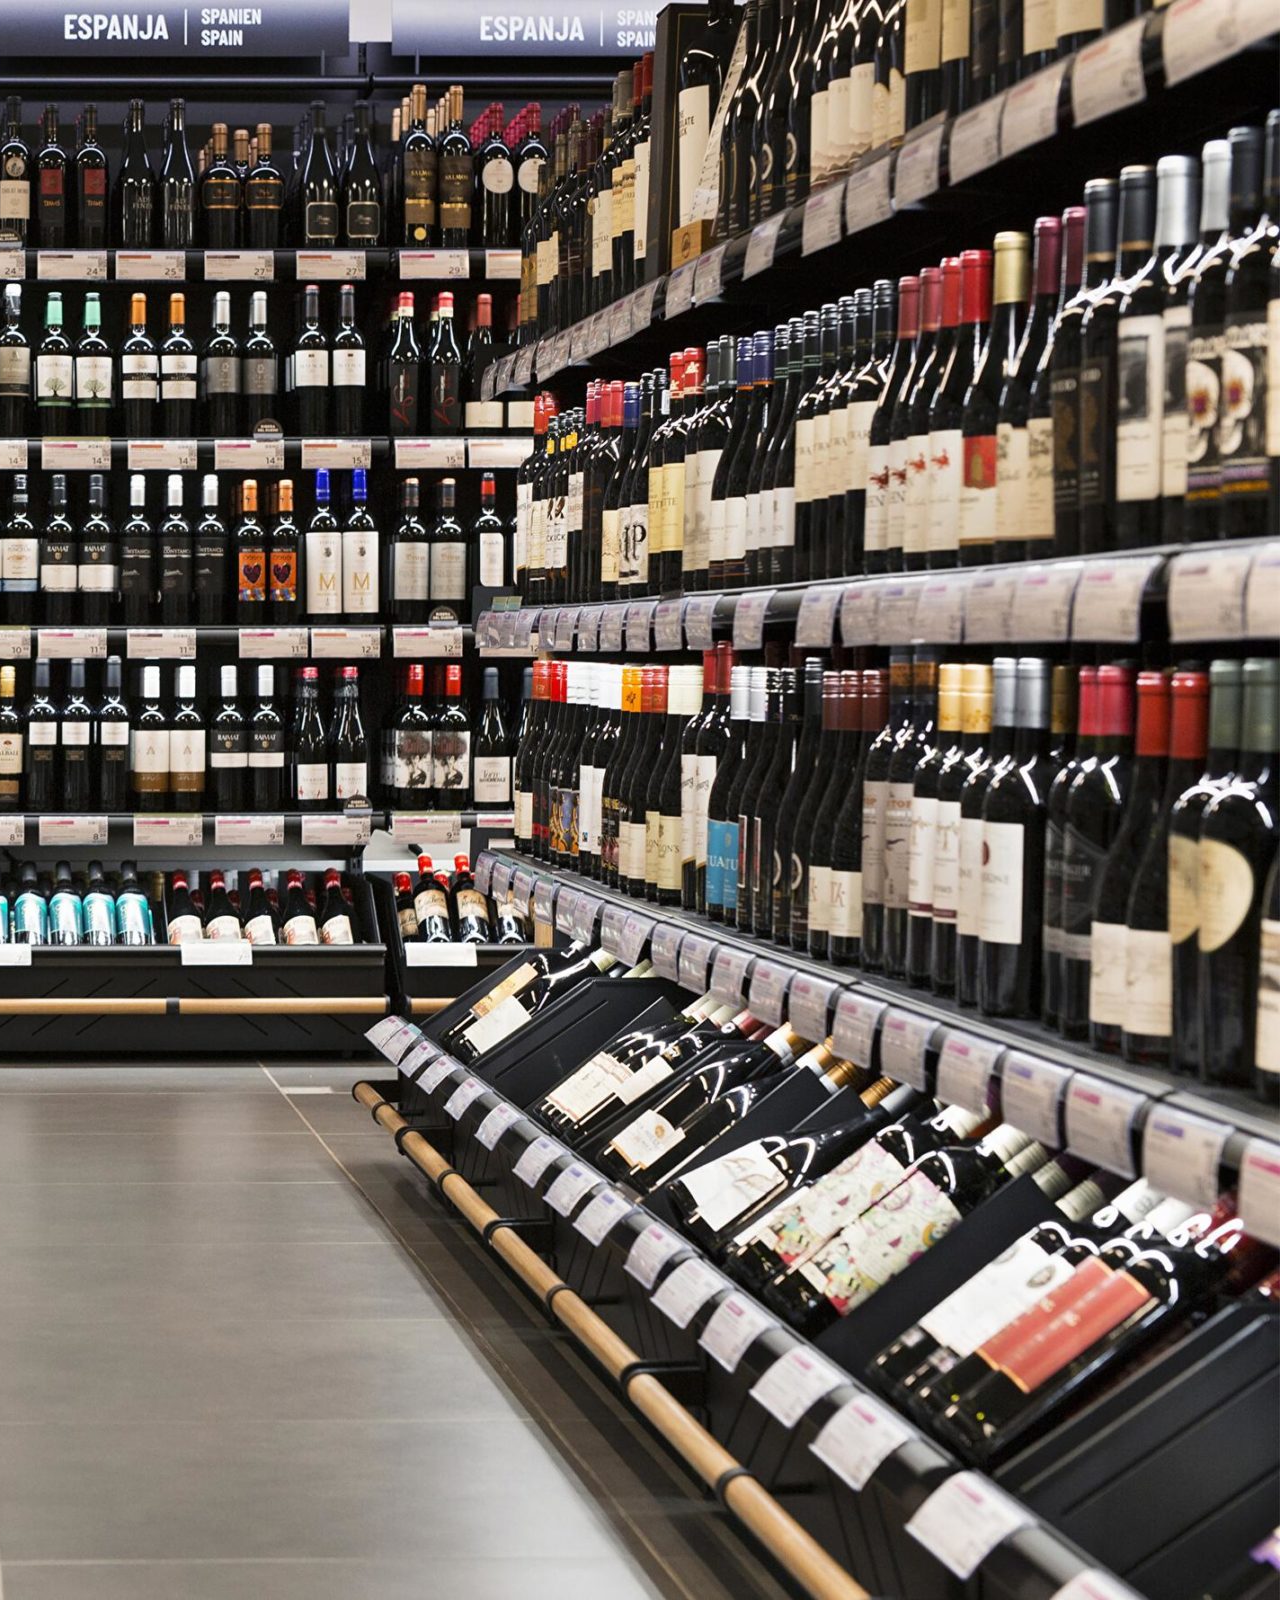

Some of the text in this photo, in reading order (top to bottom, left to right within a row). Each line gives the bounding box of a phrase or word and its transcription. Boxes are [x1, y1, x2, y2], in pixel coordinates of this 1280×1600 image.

[201, 8, 262, 25] SPANIEN
[64, 15, 169, 40] ESPANJA
[480, 16, 585, 41] ESPANJA
[201, 30, 243, 46] SPAIN
[319, 572, 336, 590] M
[353, 572, 370, 590] M
